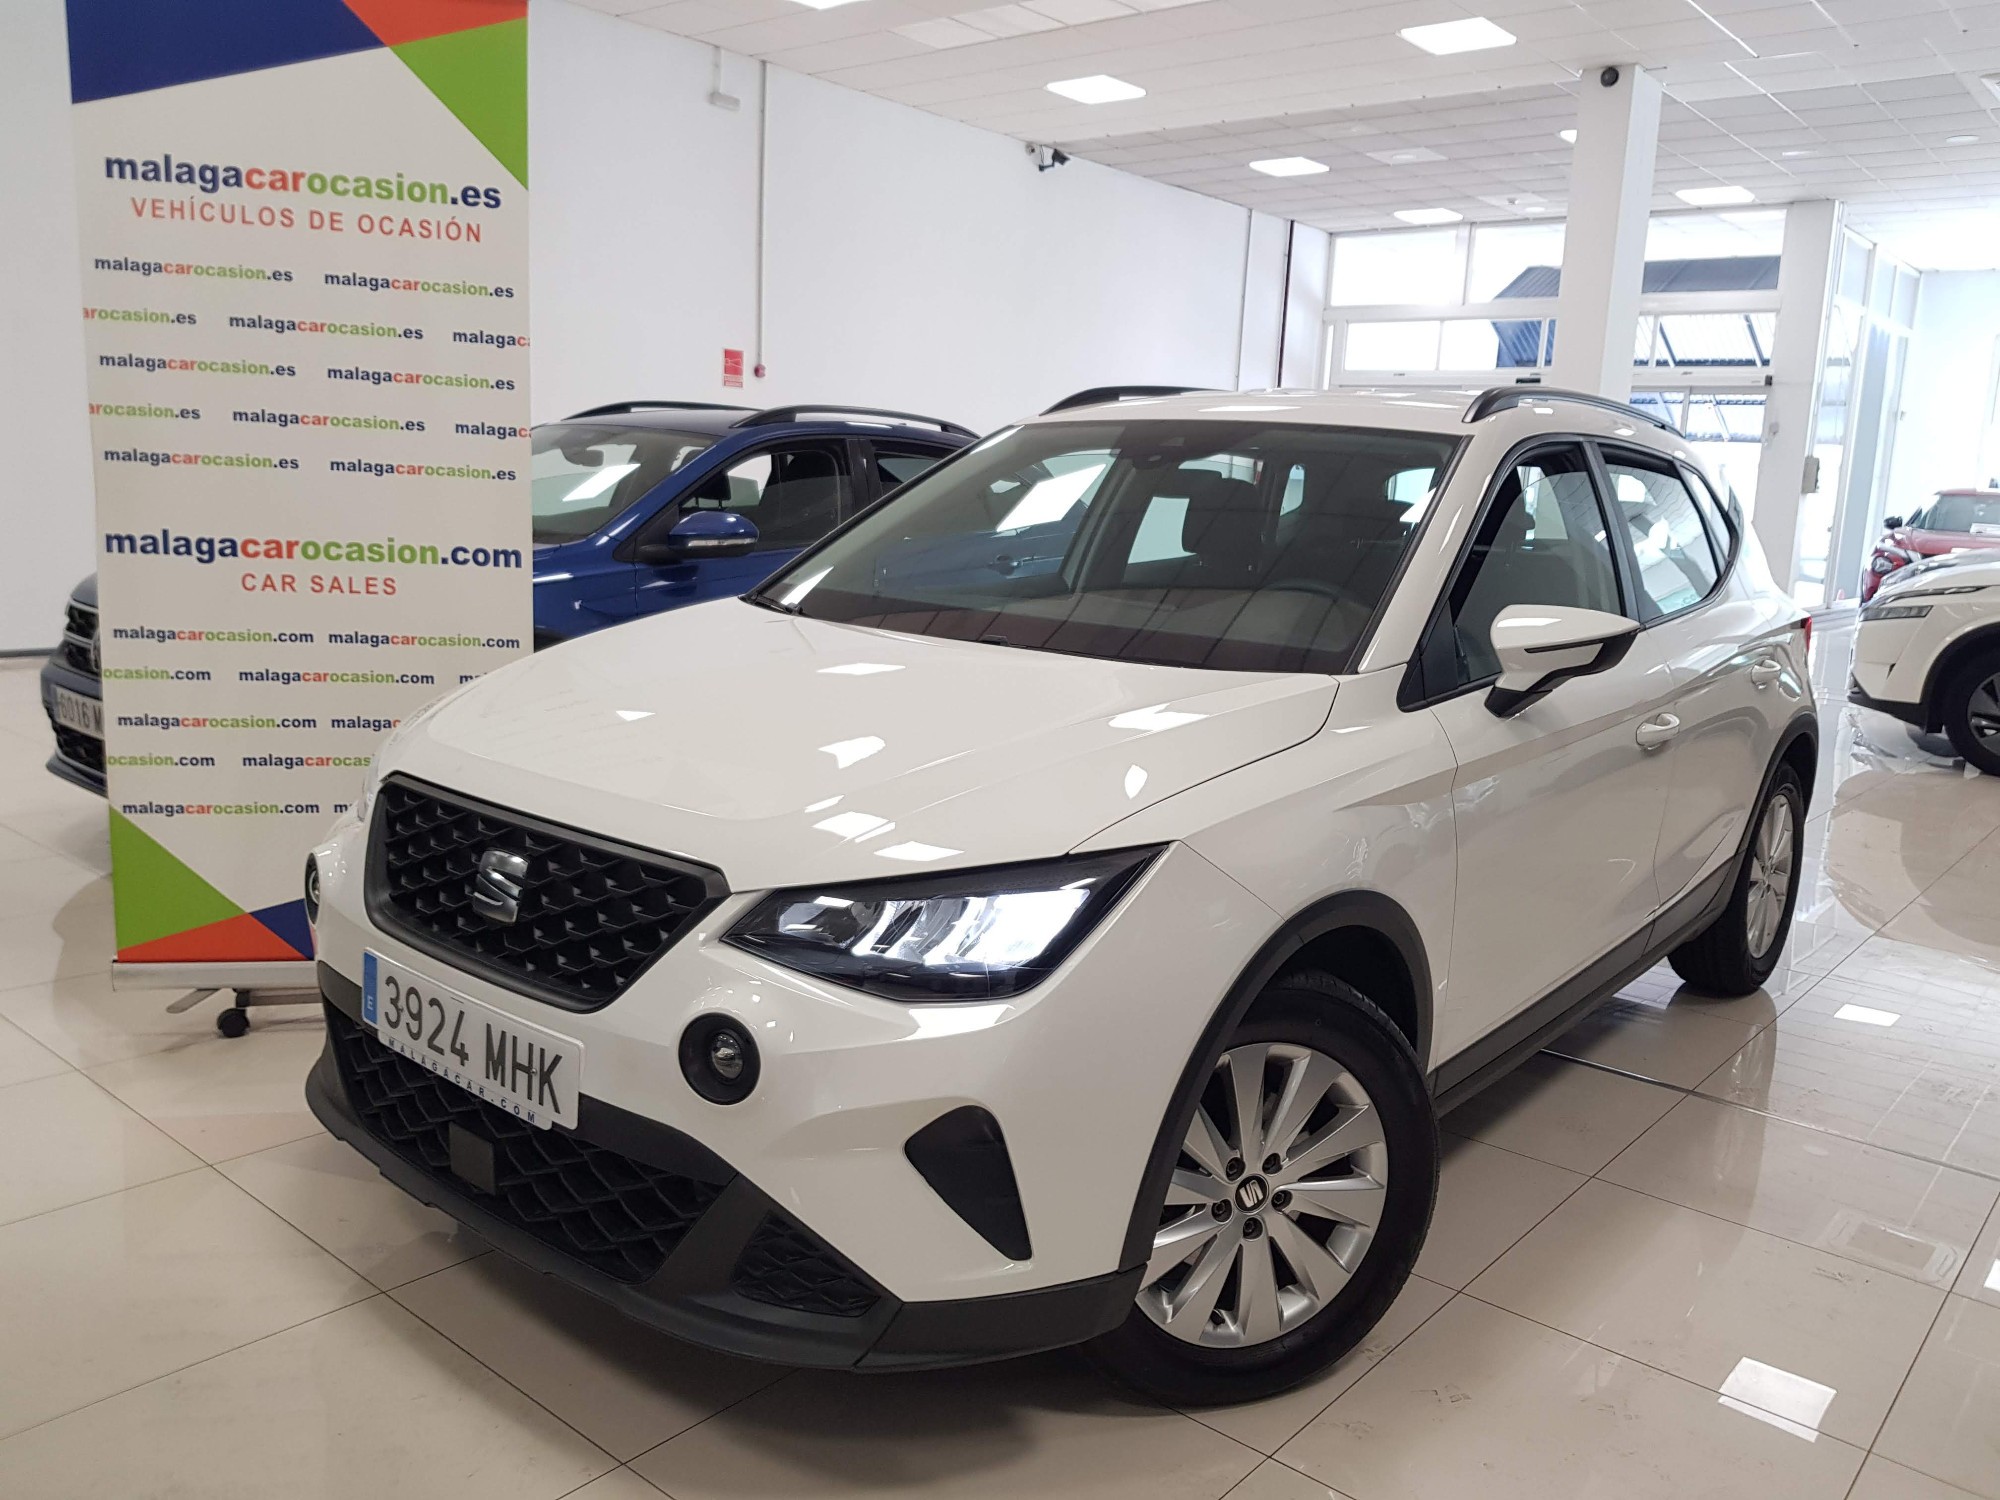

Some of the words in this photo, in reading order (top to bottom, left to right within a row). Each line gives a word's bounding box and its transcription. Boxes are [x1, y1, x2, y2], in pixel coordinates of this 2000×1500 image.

[104, 153, 501, 209] malagacarocasion.es
[132, 196, 294, 228] VEHÍCULOS
[310, 210, 343, 231] DE
[358, 214, 480, 242] OCASIÓN
[95, 257, 293, 282] malagacarocasion.es
[325, 272, 514, 298] malagacarocasion.es
[229, 315, 423, 339] malagacarocasion.es
[100, 353, 296, 376] malagacarocasion.es
[328, 366, 515, 390] malagacarocasion.es
[233, 409, 425, 431] malagacarocasion.es
[104, 448, 299, 469] malagacarocasion.es
[330, 459, 516, 480] malagacarocasion.es
[105, 528, 522, 568] malagacarocasion.com
[242, 573, 296, 592] CAR
[311, 575, 396, 595] SALES
[113, 626, 314, 643] malagacarocasion.com
[329, 631, 520, 648] malagacarocasion.com
[239, 668, 434, 685] malagacarocasion.com
[118, 713, 317, 730] malagacarocasion.com
[121, 801, 320, 821] malagacarocasion.com
[384, 975, 469, 1067] 3924
[485, 1023, 563, 1114] MHK
[388, 1038, 536, 1124] MALAGACAR.COM
